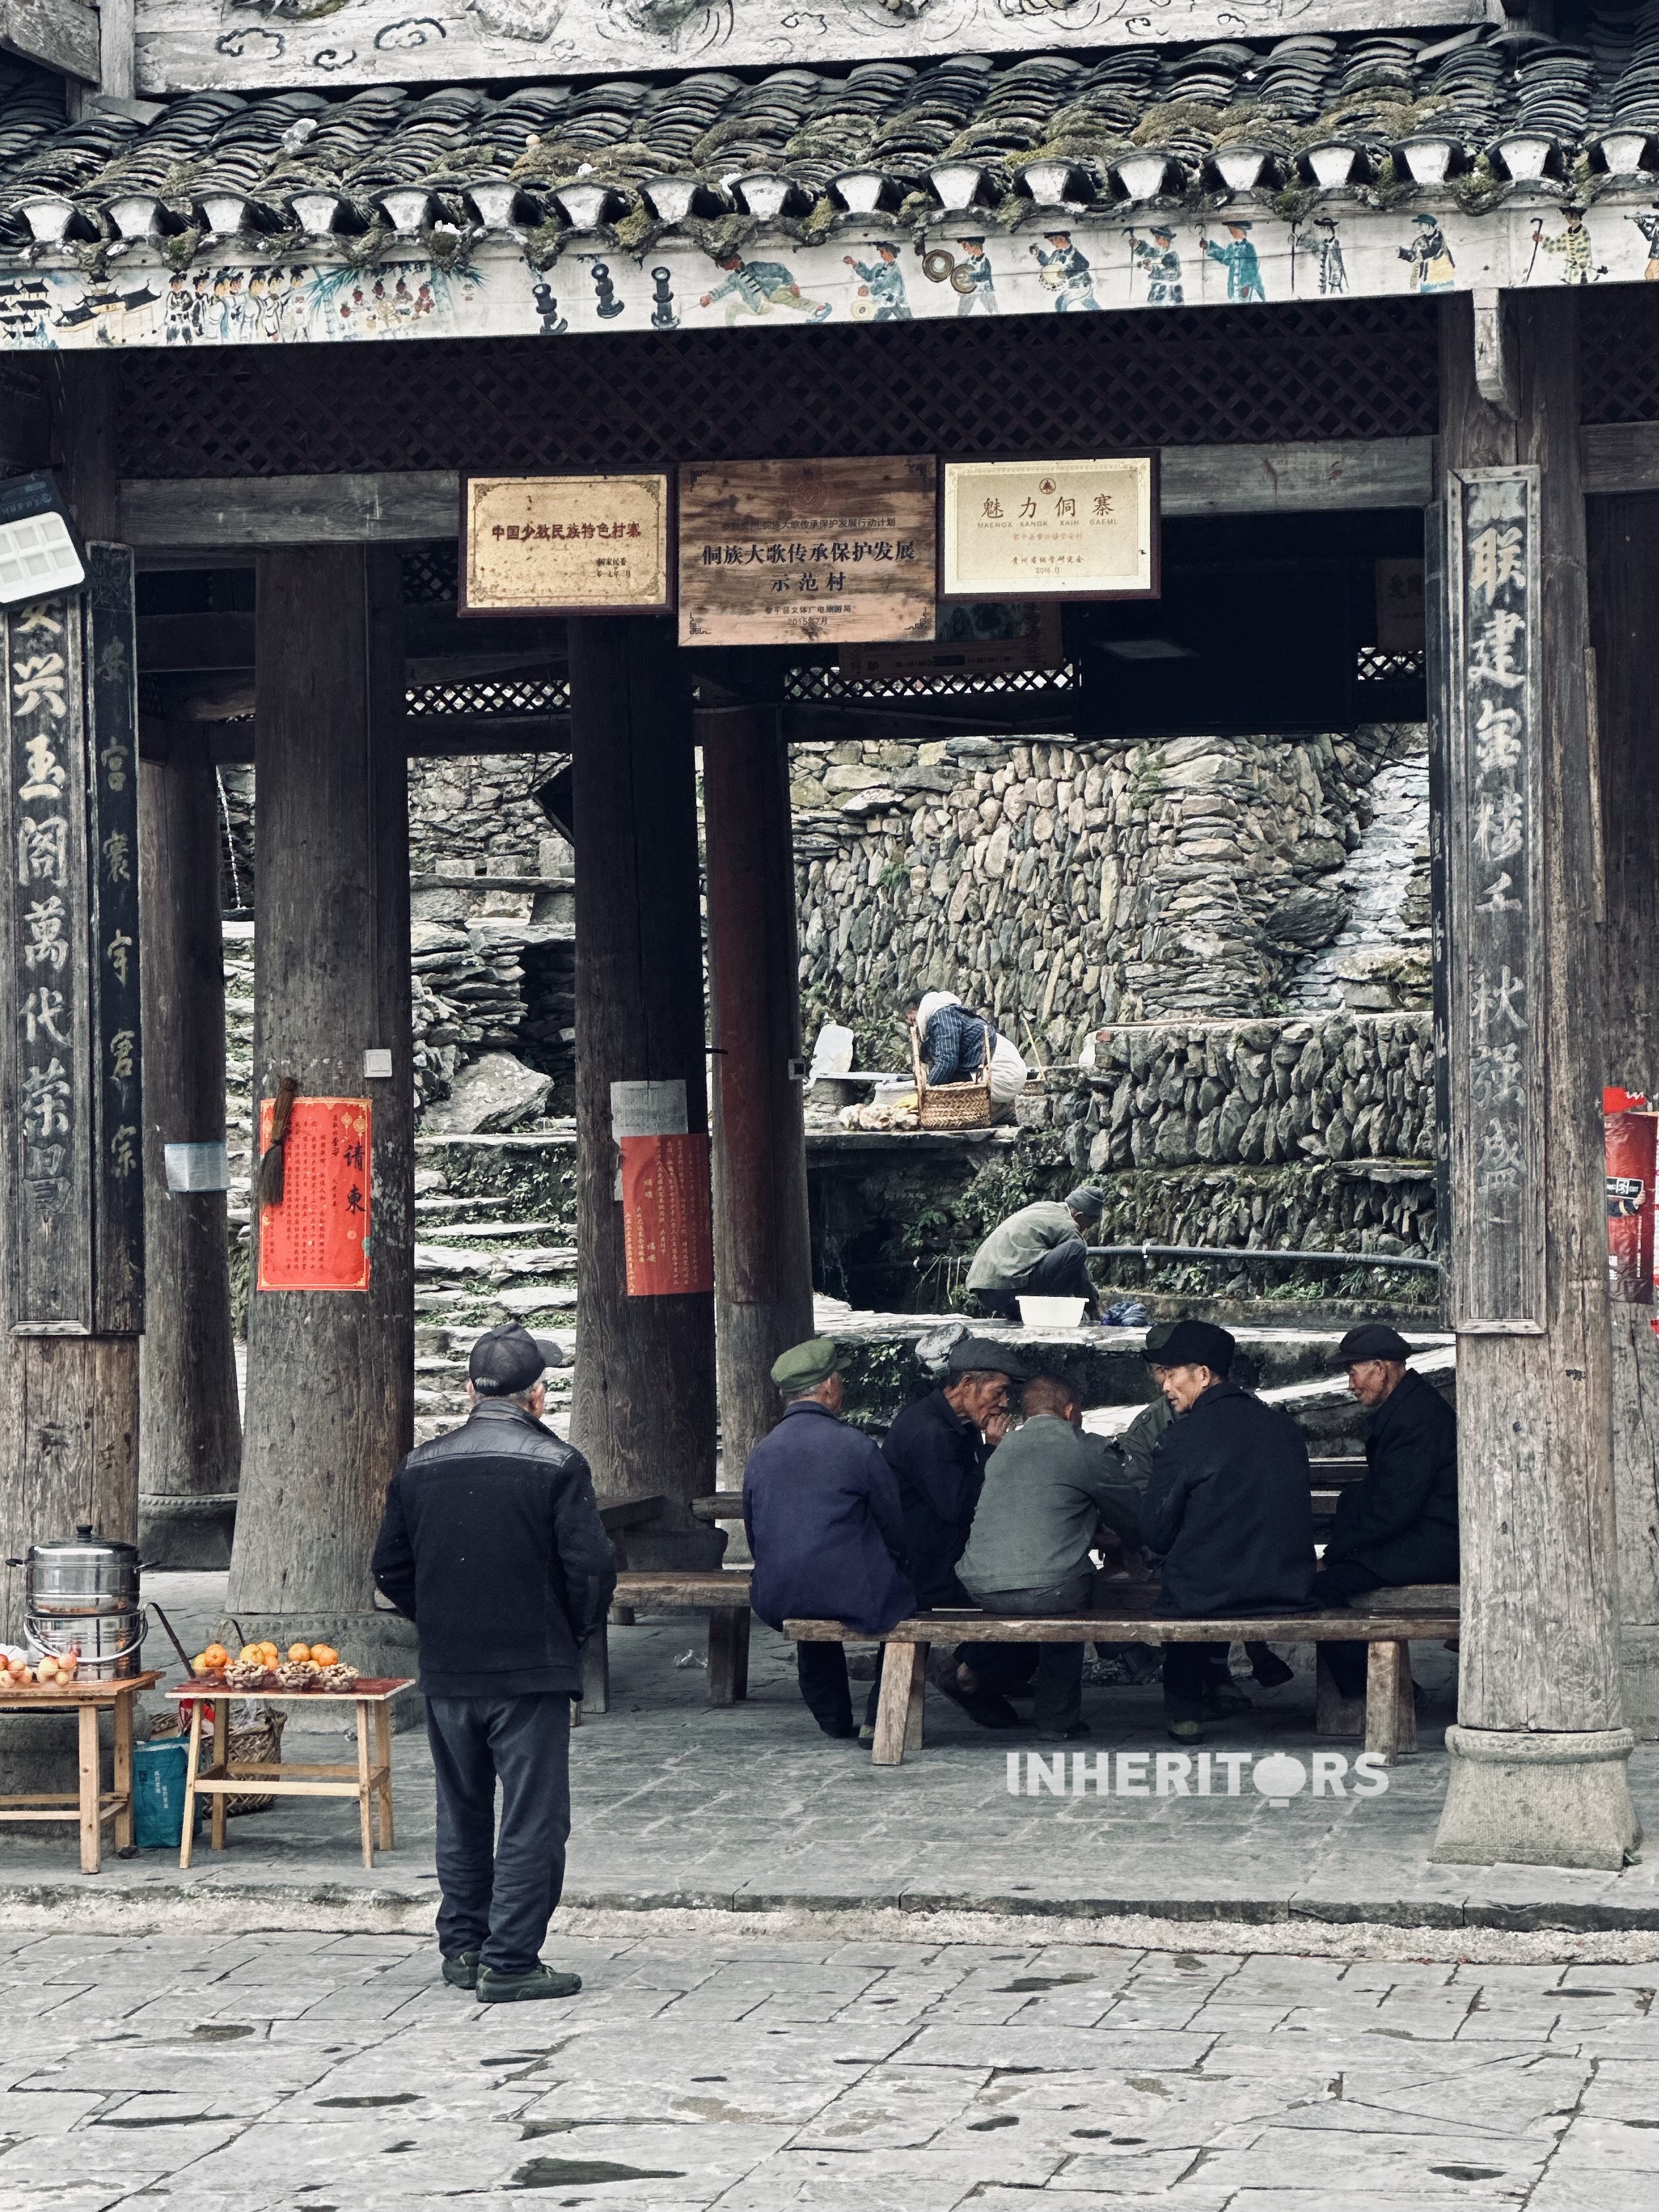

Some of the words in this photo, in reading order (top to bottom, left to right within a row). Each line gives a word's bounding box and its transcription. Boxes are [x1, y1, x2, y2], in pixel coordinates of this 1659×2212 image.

[980, 494, 1115, 519] 魅力侗寨
[492, 521, 641, 541] 中国少数民族特色村寨
[702, 540, 916, 565] 侗族大歌传承保护发展
[771, 571, 846, 593] 示范村
